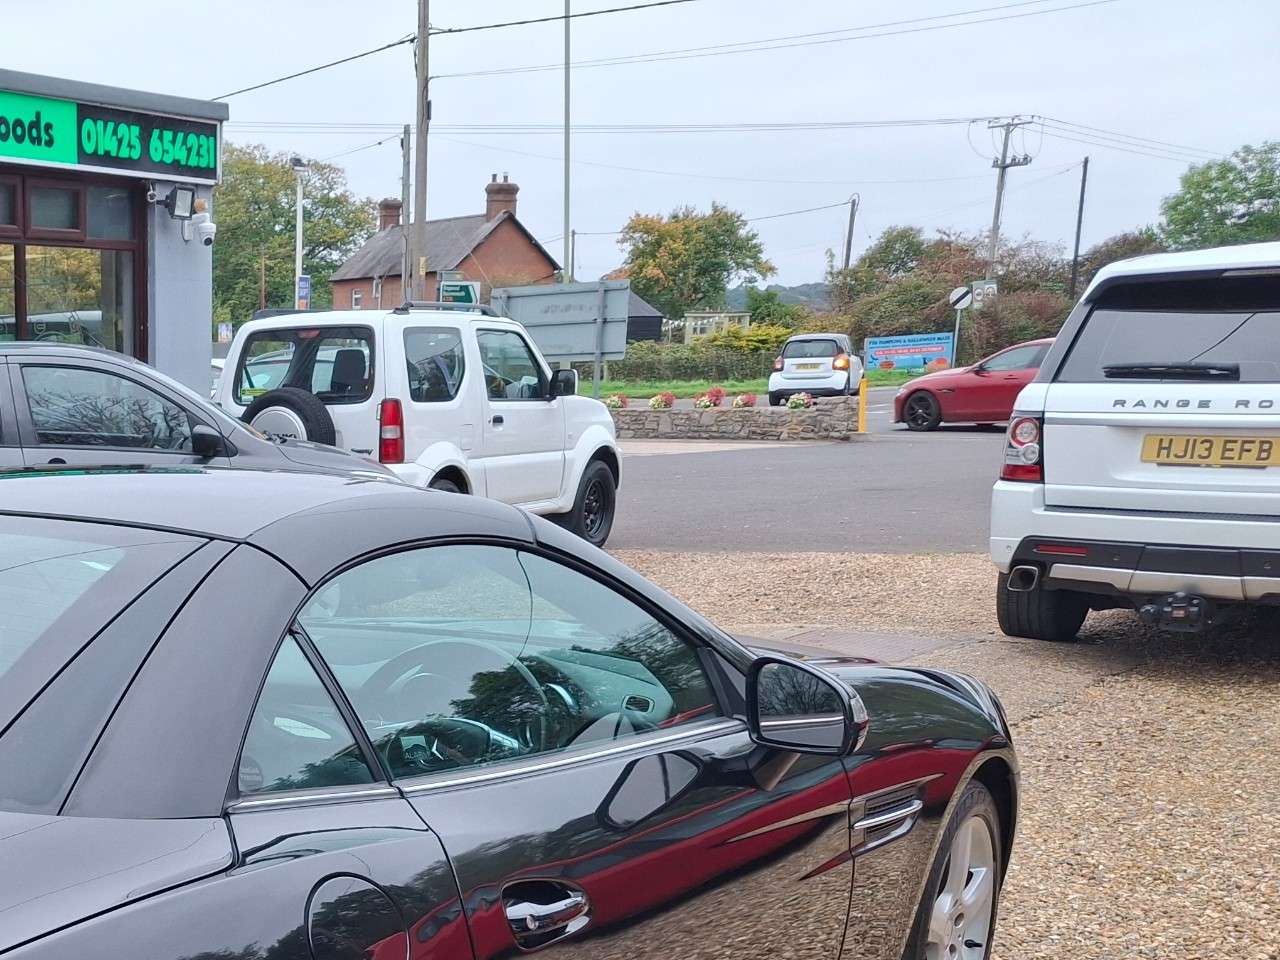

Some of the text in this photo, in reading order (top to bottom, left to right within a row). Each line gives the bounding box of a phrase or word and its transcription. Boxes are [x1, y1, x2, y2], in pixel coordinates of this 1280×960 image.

[81, 119, 216, 169] 01425 654231
[1112, 399, 1212, 408] RANGE
[1156, 438, 1274, 461] HJ13 EFB
